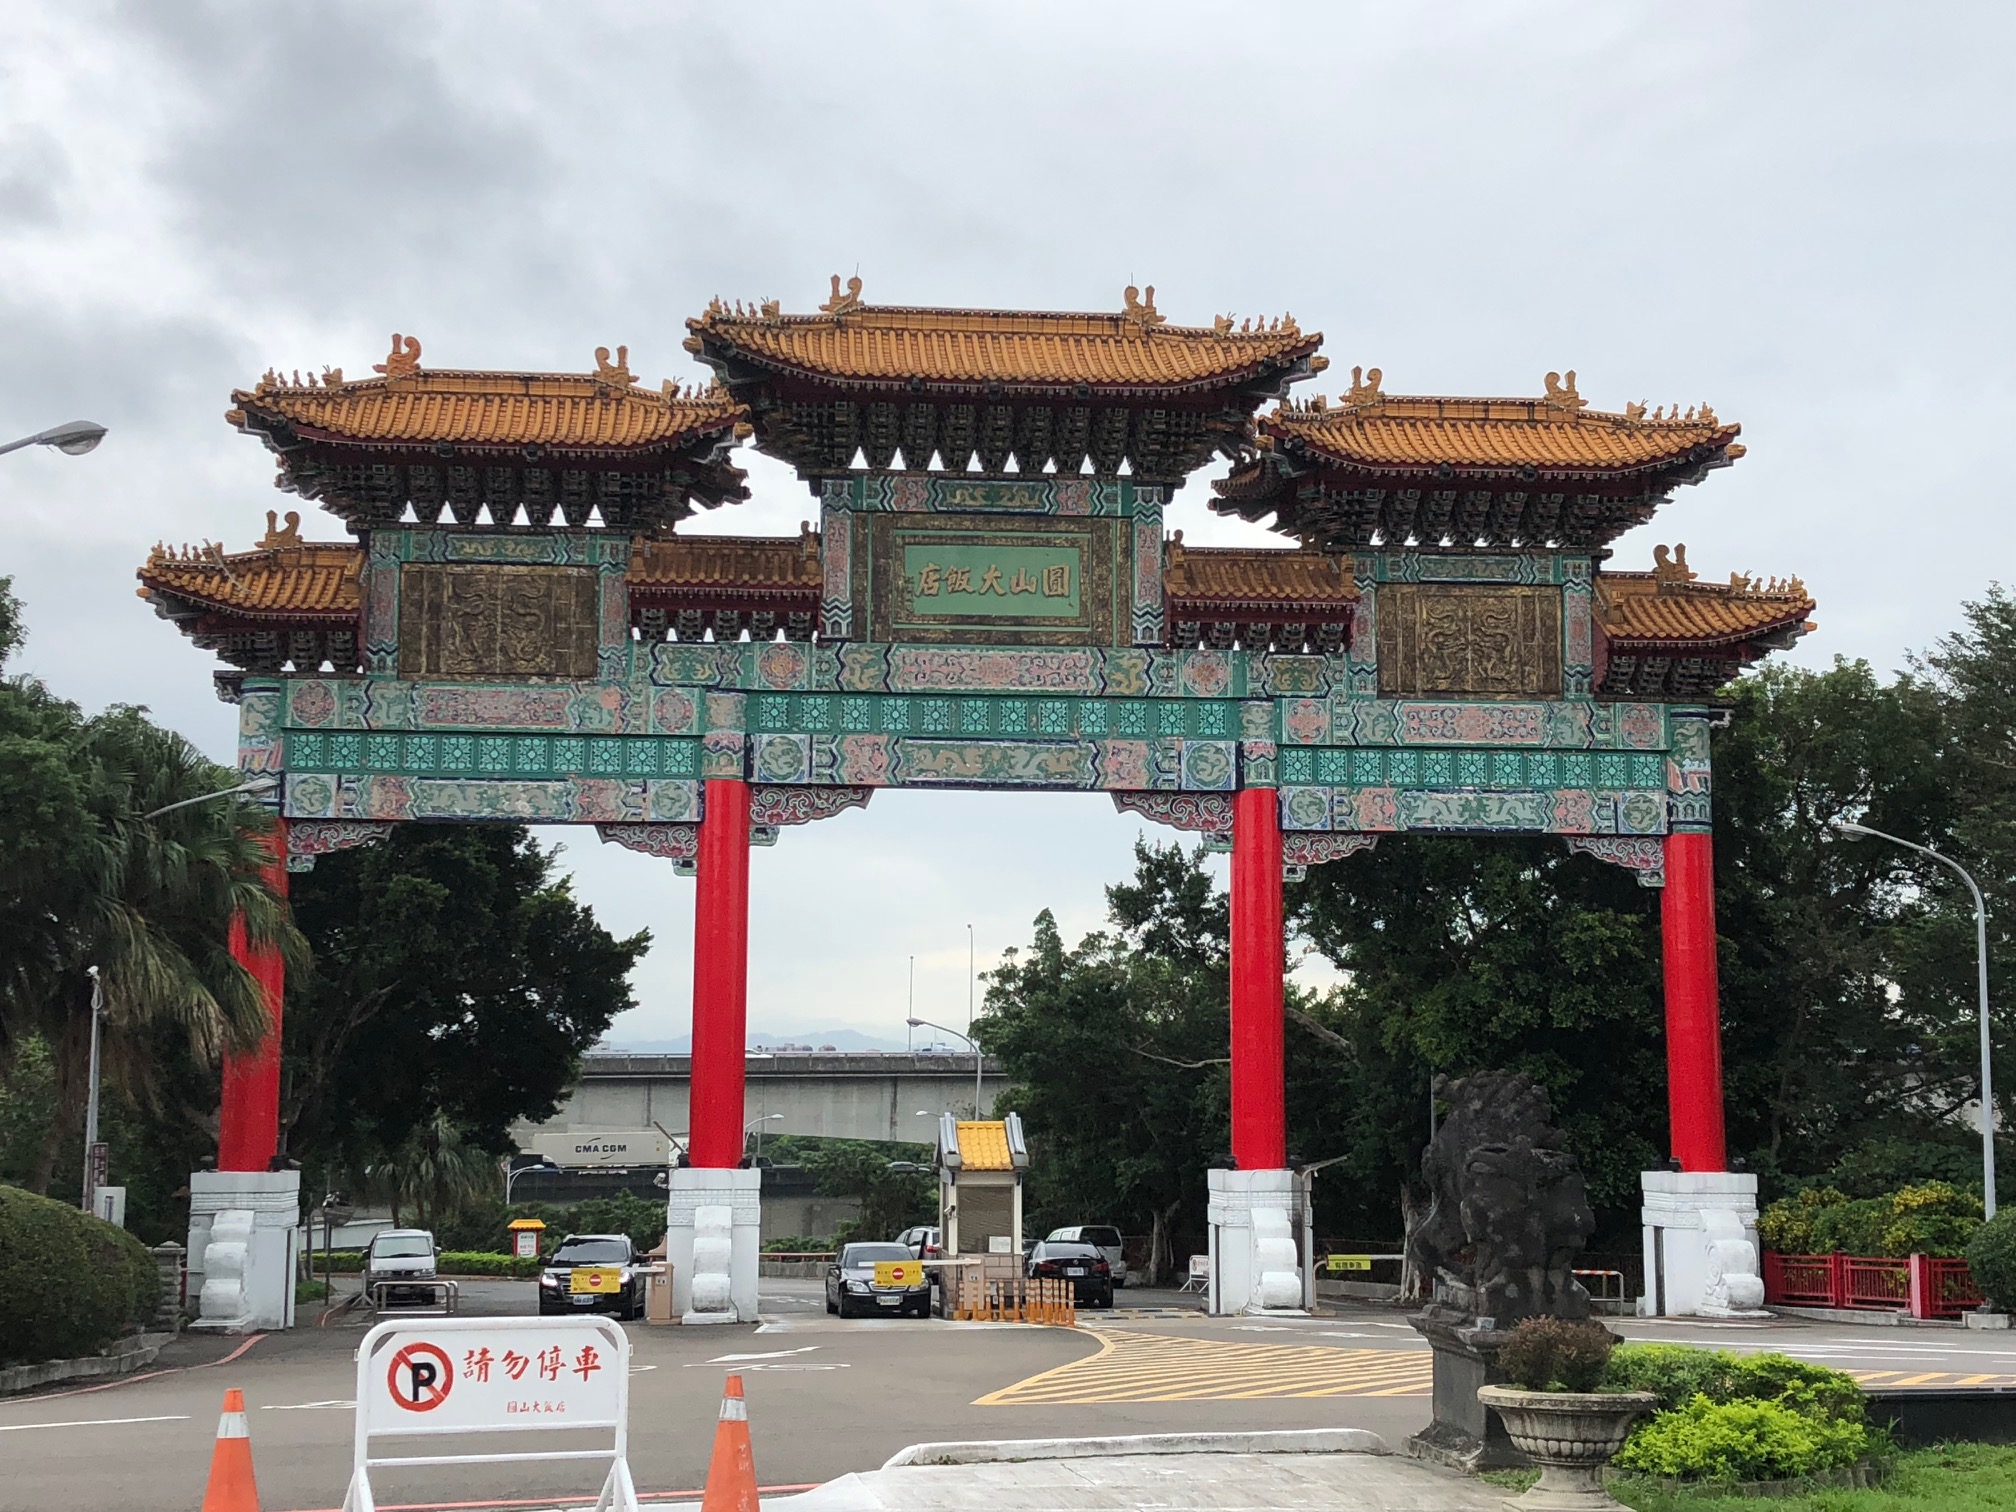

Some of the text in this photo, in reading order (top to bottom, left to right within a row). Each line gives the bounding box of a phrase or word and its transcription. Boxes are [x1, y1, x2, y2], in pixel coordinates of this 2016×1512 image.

[914, 562, 1071, 597] 圓山大飯店
[575, 1144, 627, 1153] CMA CGM
[463, 1345, 602, 1383] 請勿停車
[506, 1400, 567, 1414] 圓山大飯店
